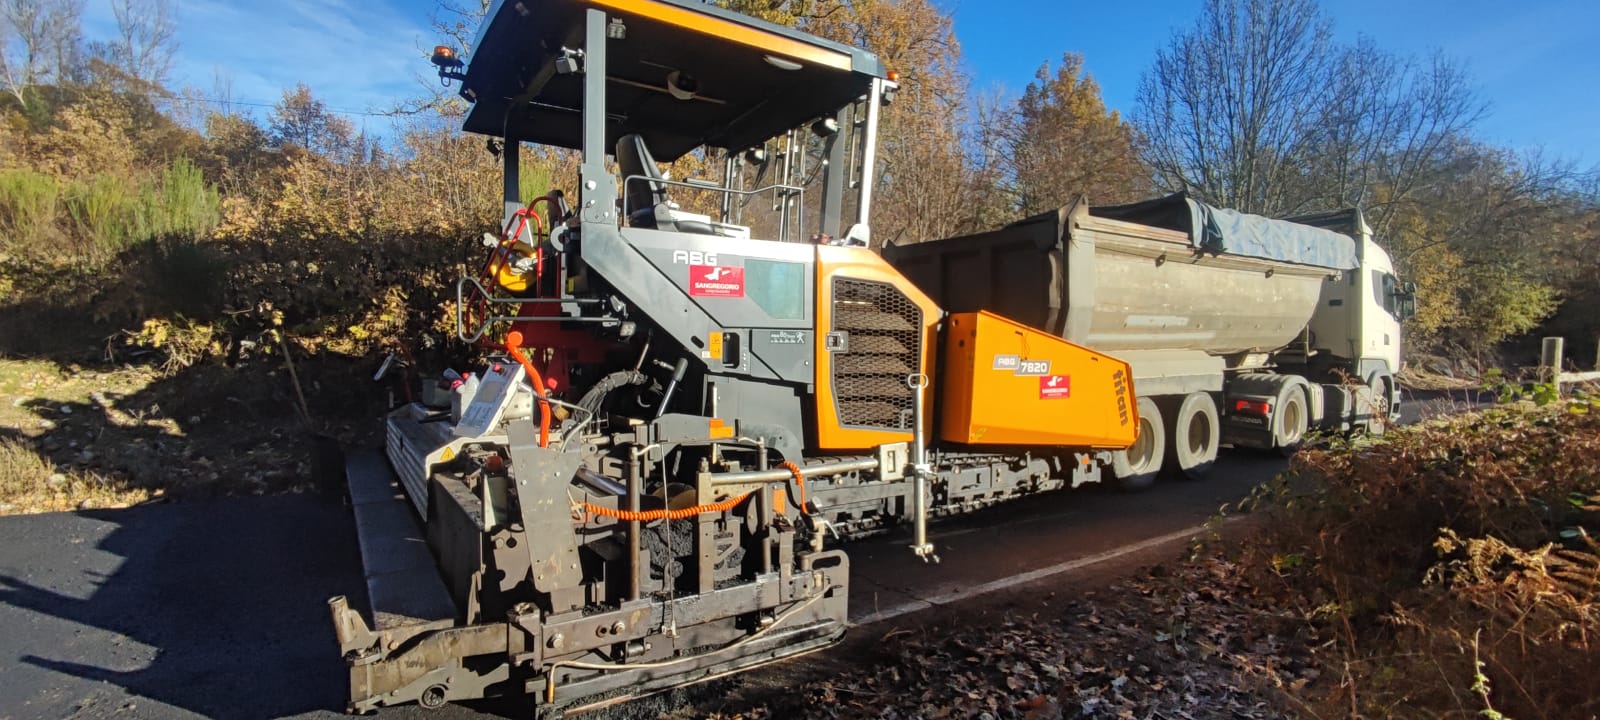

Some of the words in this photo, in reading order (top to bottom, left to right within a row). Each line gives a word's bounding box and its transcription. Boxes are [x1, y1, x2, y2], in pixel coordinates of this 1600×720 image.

[673, 250, 717, 266] ABG
[694, 282, 740, 290] SANGREGORIO
[1020, 362, 1048, 373] 7820
[1112, 369, 1128, 426] titan
